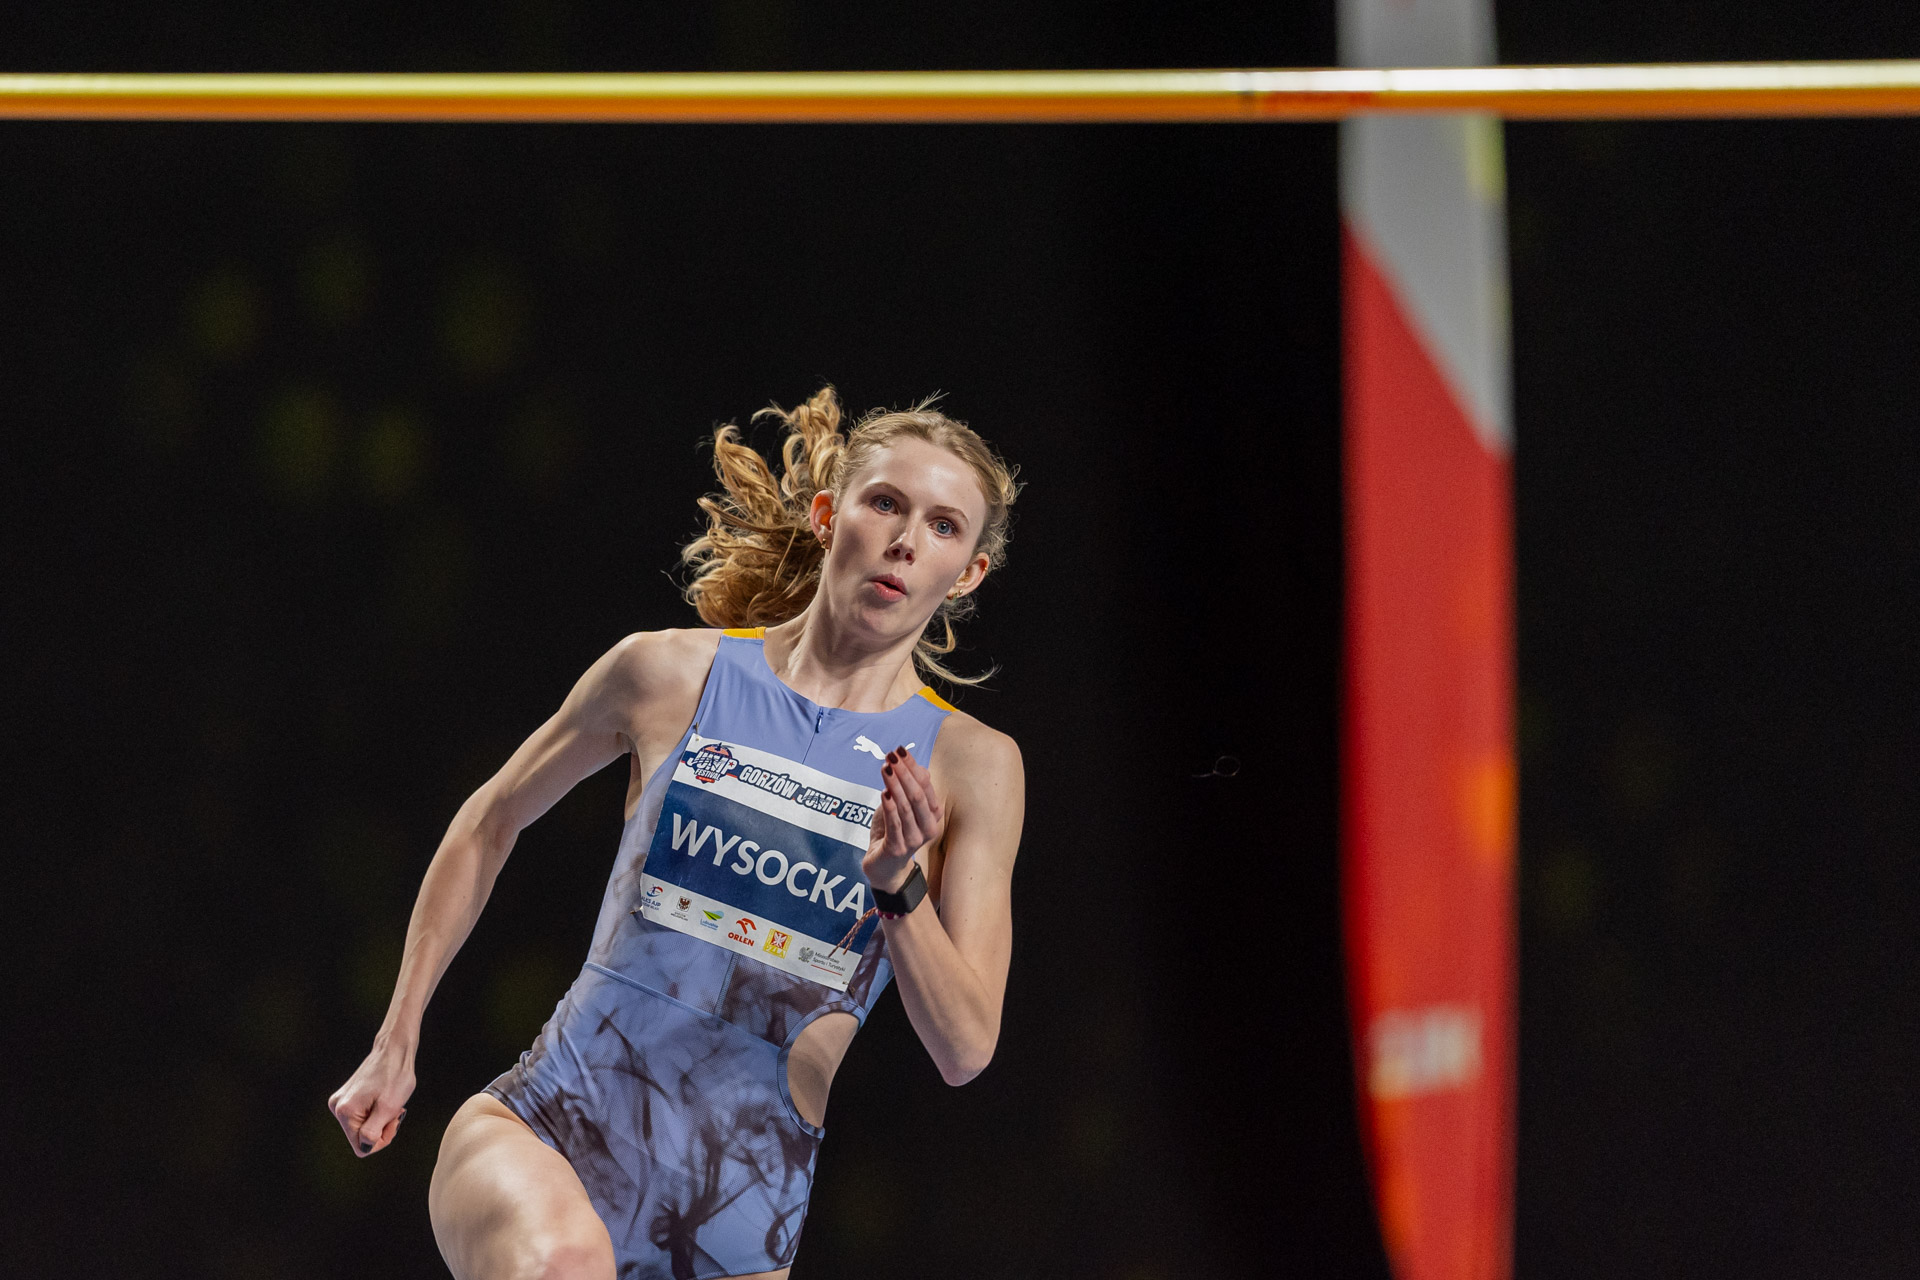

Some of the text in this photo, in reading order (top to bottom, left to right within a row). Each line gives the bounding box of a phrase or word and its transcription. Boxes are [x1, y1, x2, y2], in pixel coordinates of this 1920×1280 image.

[687, 751, 738, 775] JUMP
[695, 768, 721, 781] FESTIVAL
[739, 766, 799, 799] GORZÓW
[797, 788, 841, 814] JUMP
[671, 812, 866, 920] WYSOCKA
[728, 931, 755, 947] ORLEN
